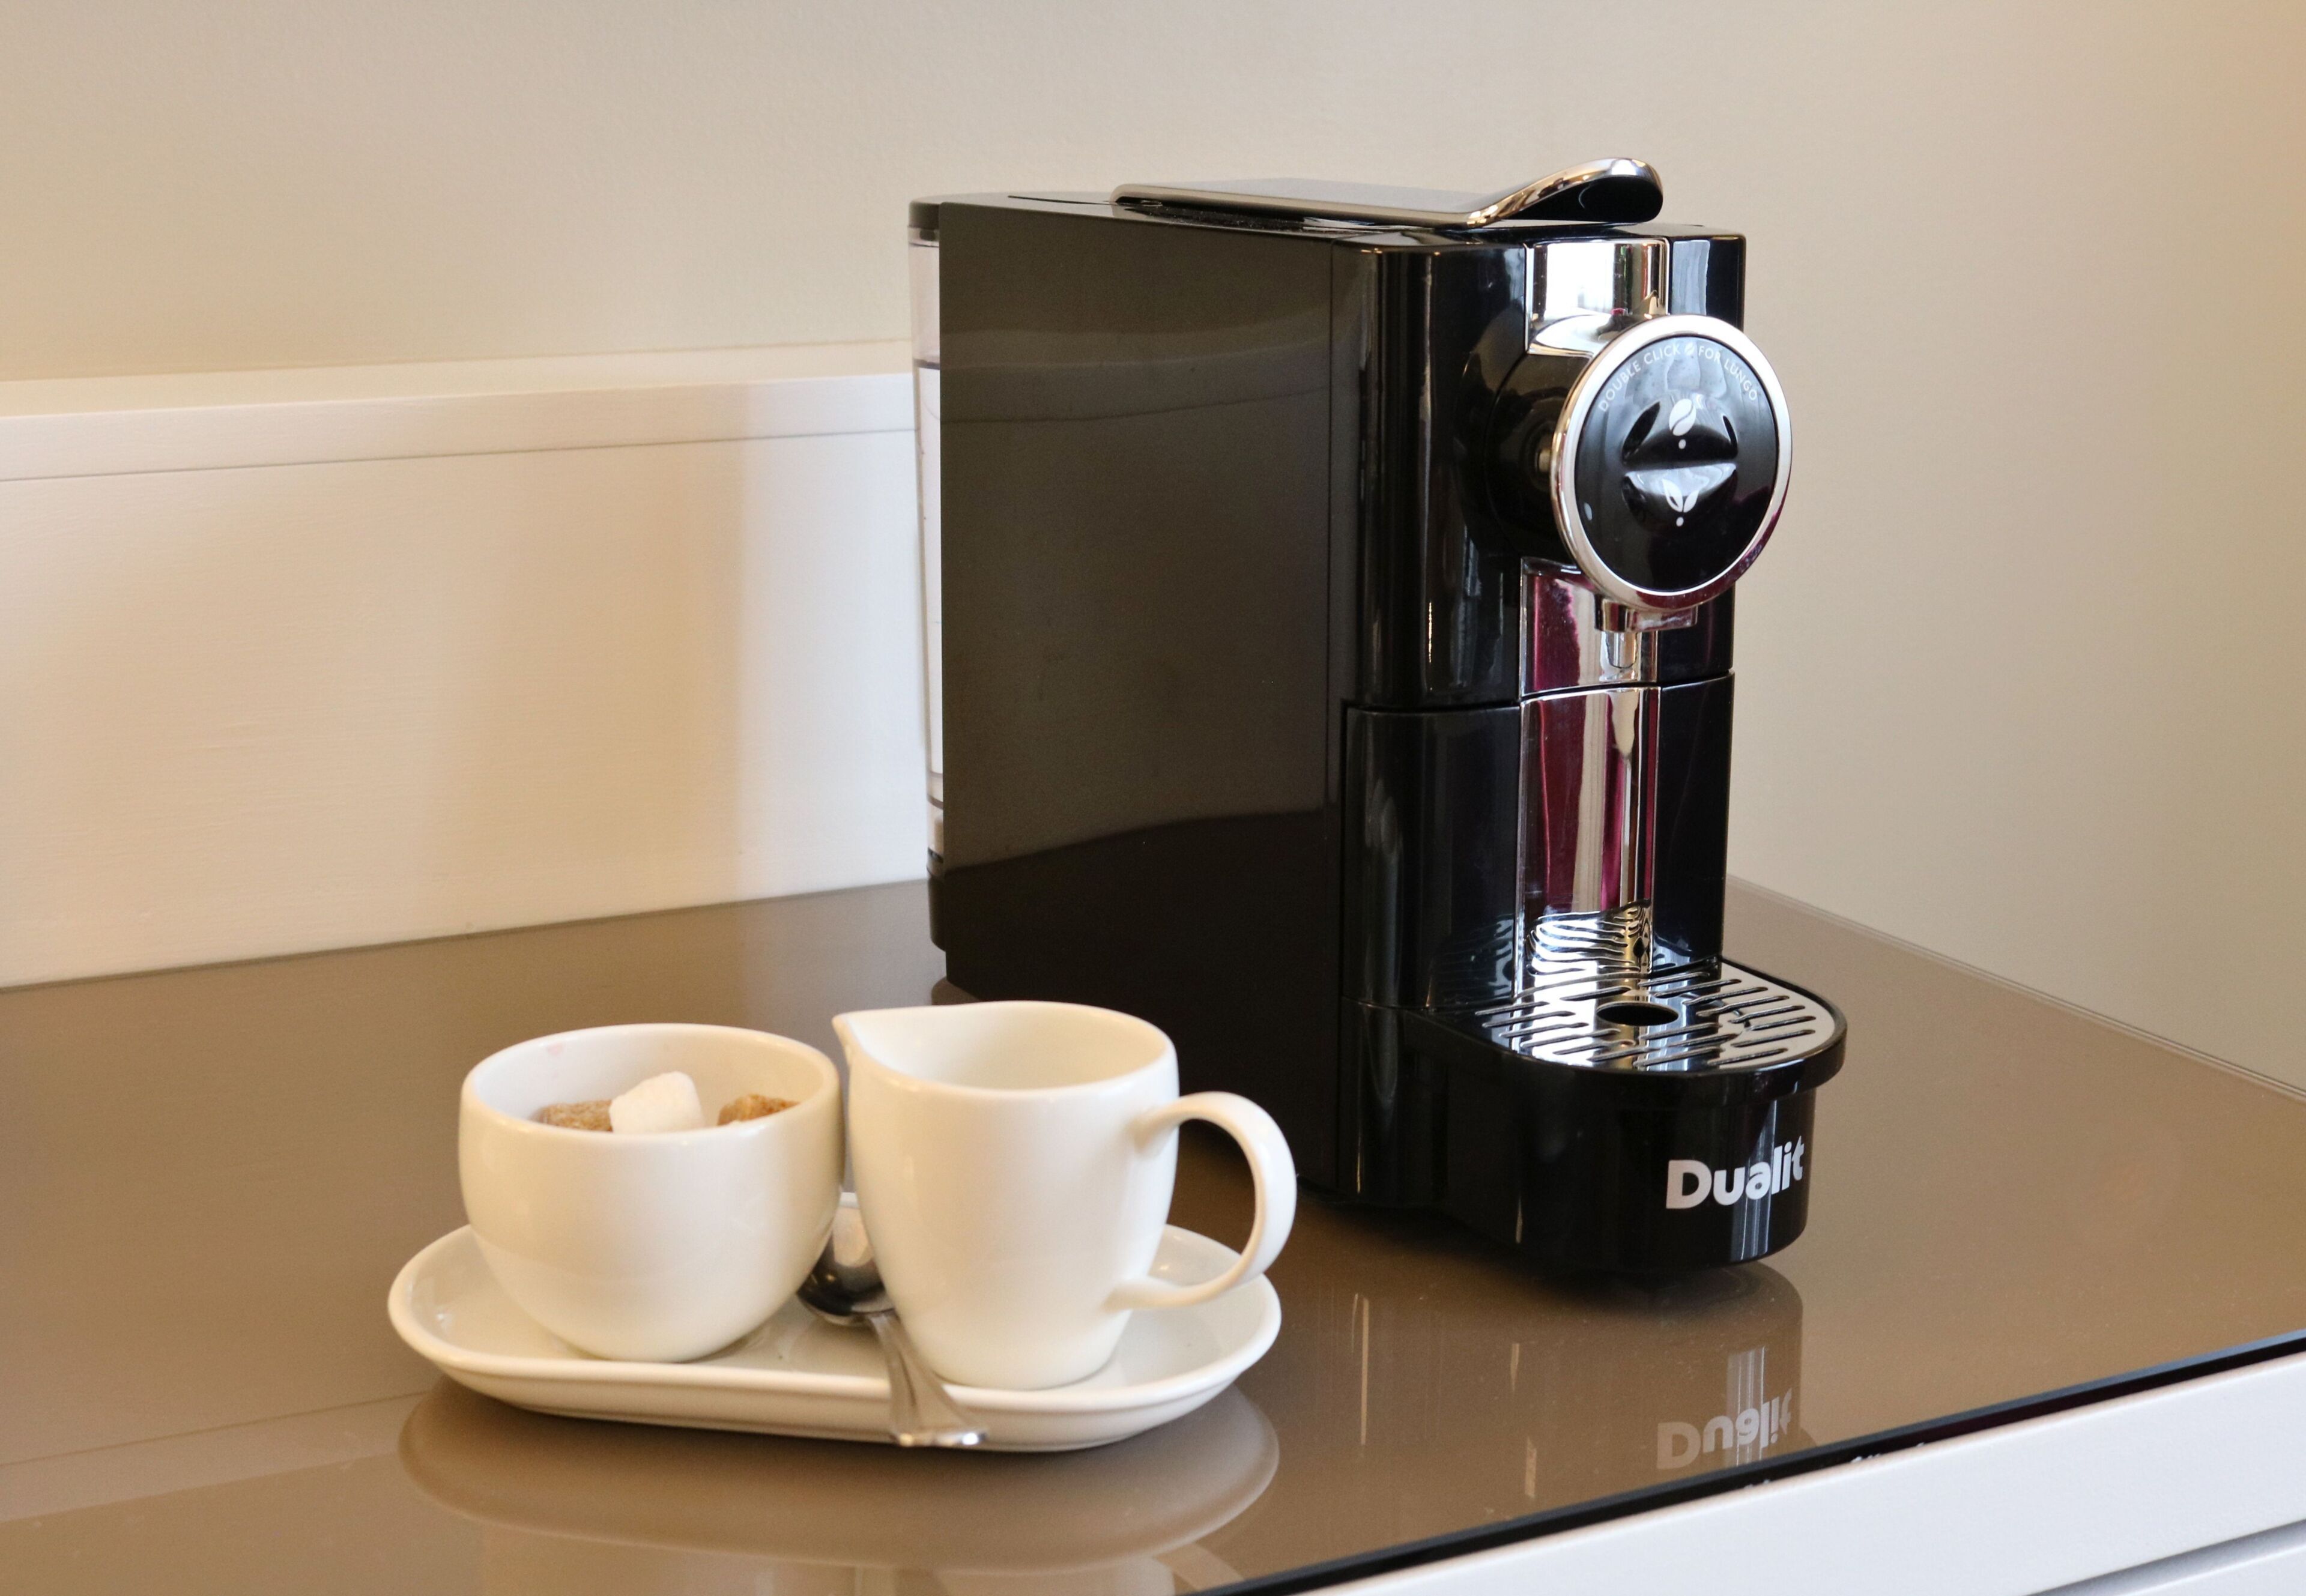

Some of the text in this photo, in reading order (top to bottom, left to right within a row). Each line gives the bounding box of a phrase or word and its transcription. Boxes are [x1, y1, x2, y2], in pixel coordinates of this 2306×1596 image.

[1598, 343, 1757, 412] DOUBLE CLICK FOR LUNGO
[1666, 1135, 1804, 1209] Dualit
